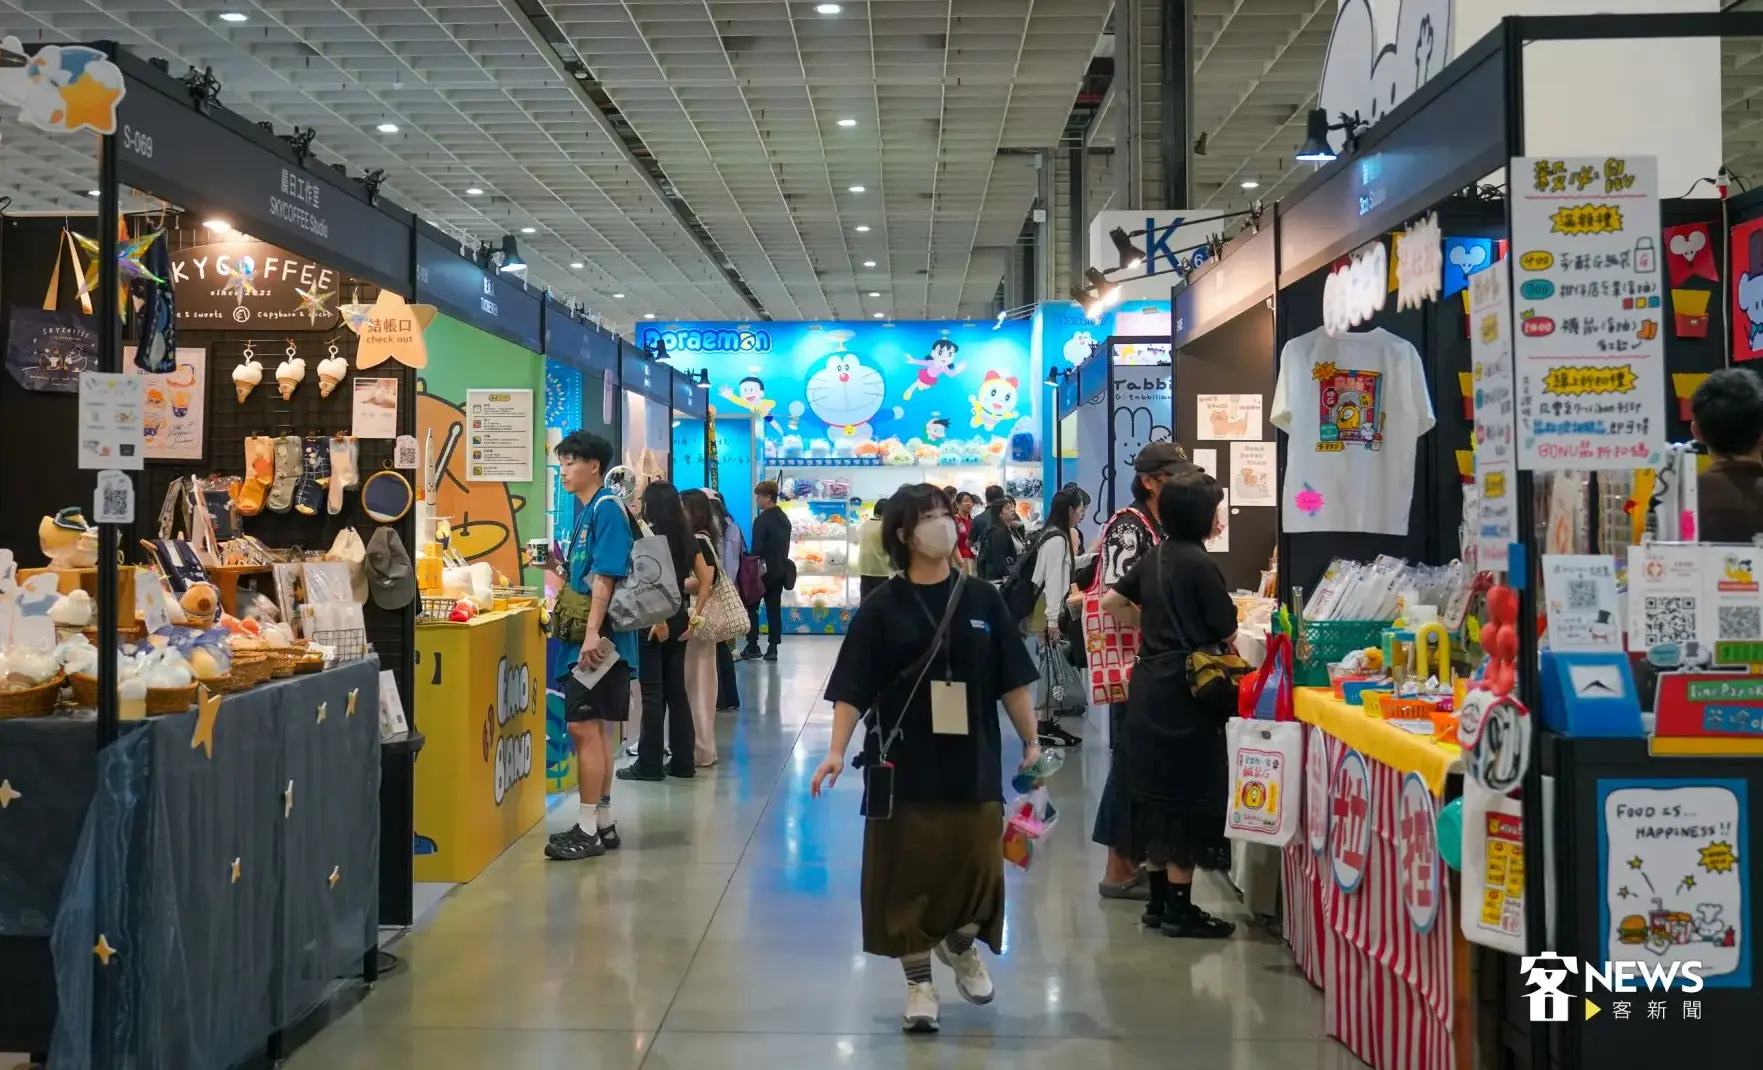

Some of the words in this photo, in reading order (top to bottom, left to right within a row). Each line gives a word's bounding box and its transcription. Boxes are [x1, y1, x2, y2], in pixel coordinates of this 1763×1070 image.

[123, 126, 153, 158] S-069
[270, 196, 309, 230] SKYCOFFEE
[310, 214, 328, 238] Studio
[1146, 217, 1186, 278] K
[171, 255, 333, 290] KYCOFFEE
[210, 288, 239, 297] since
[193, 311, 223, 319] sweets
[368, 318, 412, 334] 結帳口
[366, 335, 394, 344] check
[397, 336, 413, 344] out
[643, 327, 771, 353] Doraemon
[497, 655, 530, 727] EMO
[1721, 683, 1744, 697] Pay
[494, 729, 532, 806] BAND
